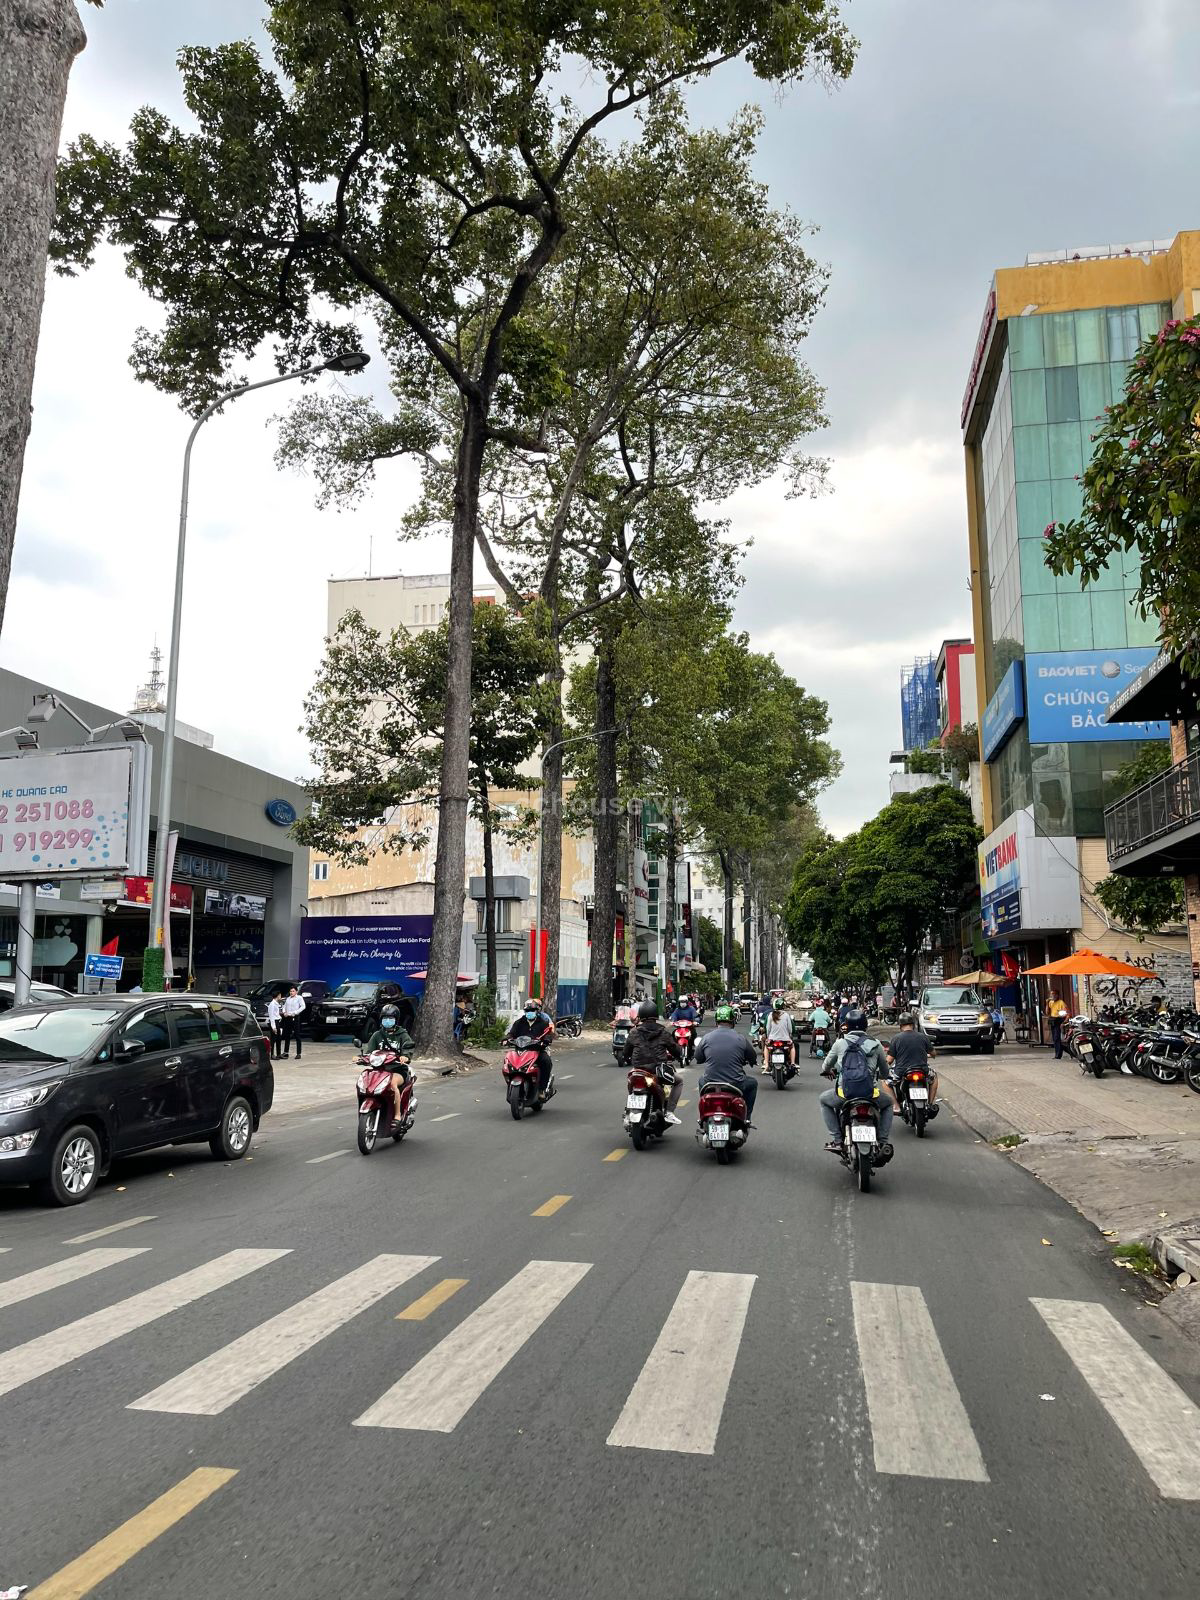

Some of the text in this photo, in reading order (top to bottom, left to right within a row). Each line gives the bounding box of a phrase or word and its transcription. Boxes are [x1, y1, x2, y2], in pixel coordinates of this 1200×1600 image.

[1038, 665, 1097, 678] BAOVIET
[1043, 688, 1110, 707] CHỨNG
[15, 799, 94, 823] 251088
[13, 828, 94, 852] 919299
[985, 832, 1018, 878] VIETBANK
